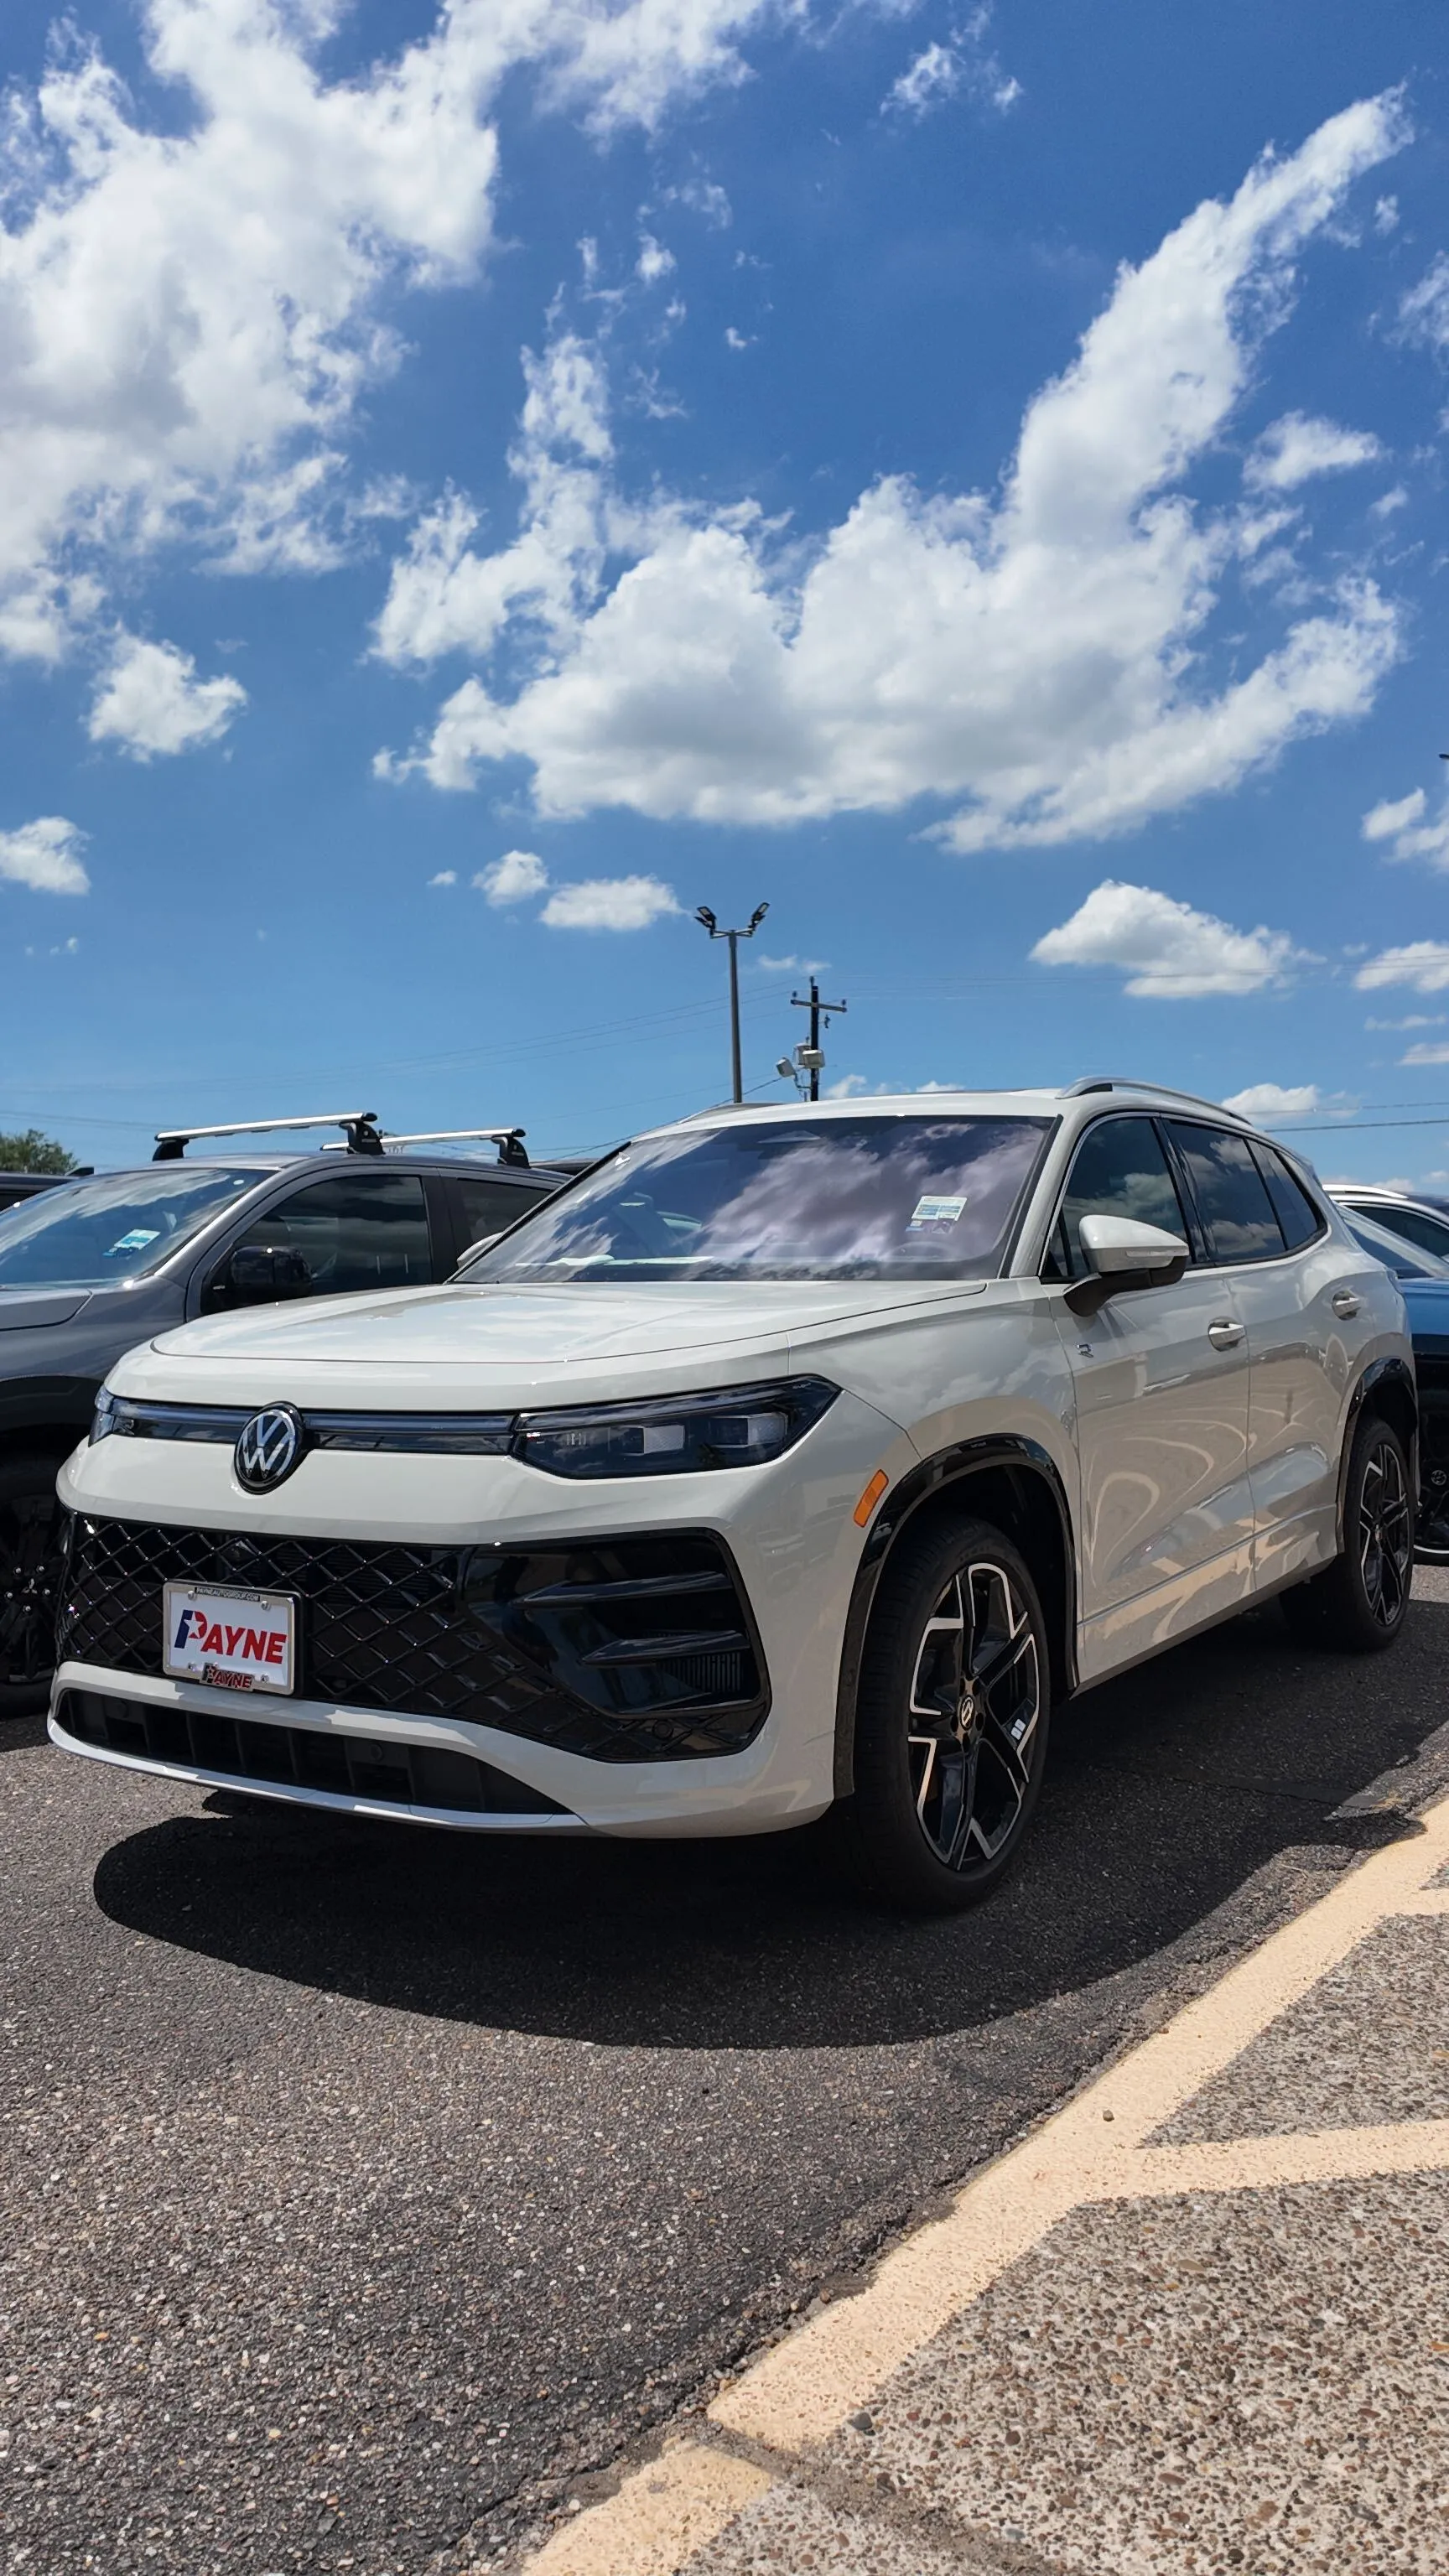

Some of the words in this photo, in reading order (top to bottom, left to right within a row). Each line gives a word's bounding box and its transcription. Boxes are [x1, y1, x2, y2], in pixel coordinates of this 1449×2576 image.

[238, 1410, 294, 1484] VW
[174, 1609, 287, 1665] PAYNE
[202, 1663, 252, 1689] PAYNE
